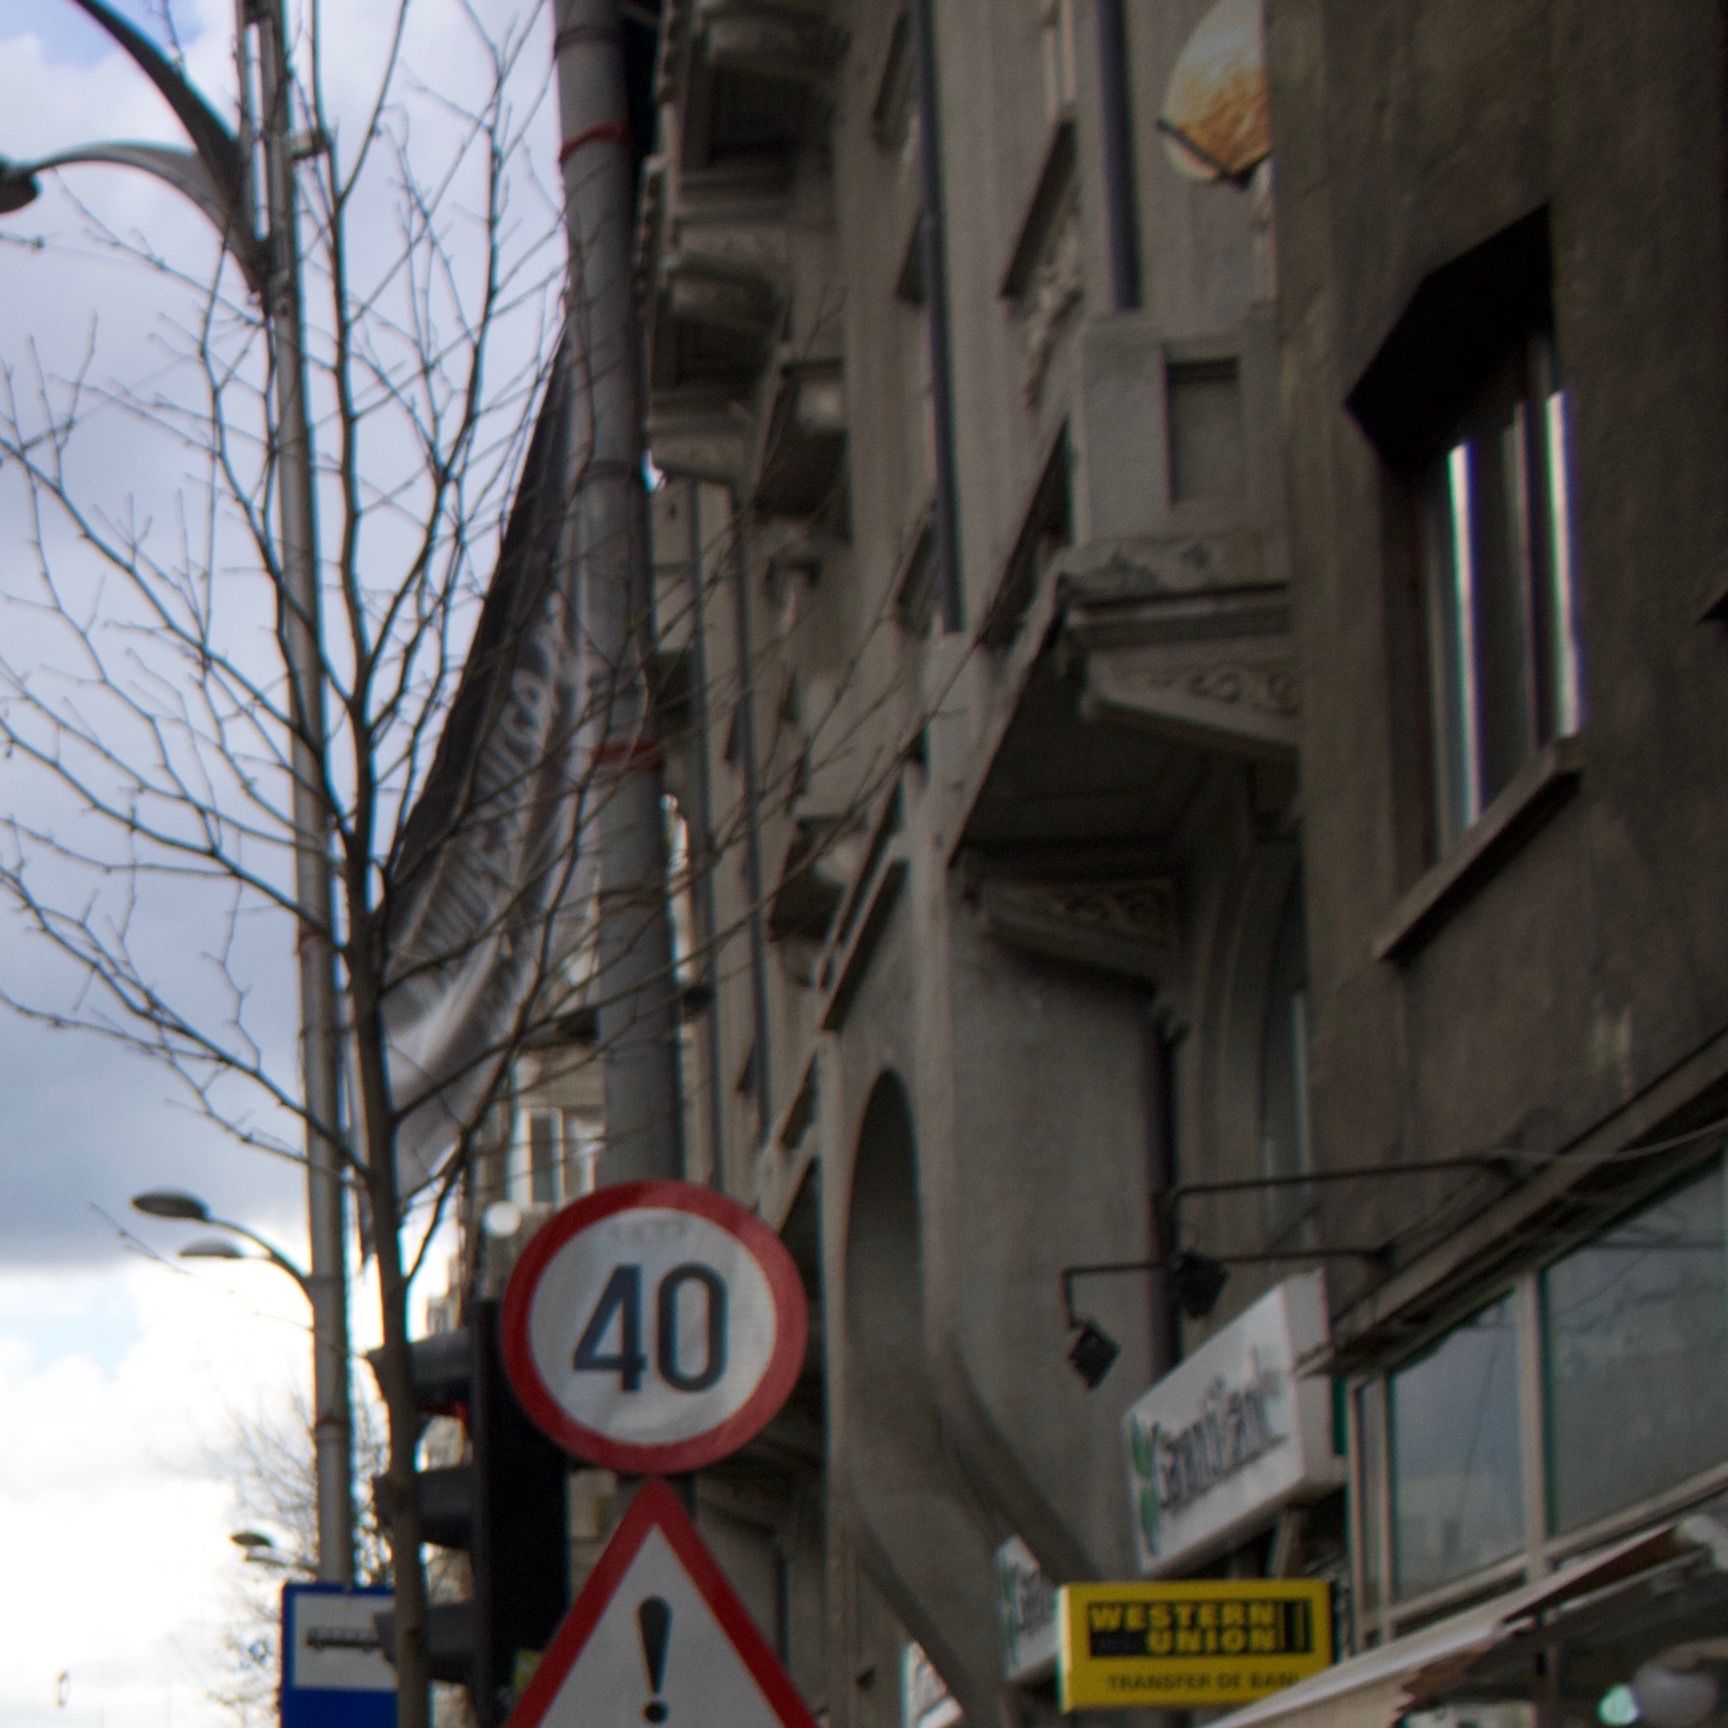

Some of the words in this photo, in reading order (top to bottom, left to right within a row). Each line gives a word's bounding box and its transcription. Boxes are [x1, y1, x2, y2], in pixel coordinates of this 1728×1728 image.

[572, 1262, 728, 1393] 40
[1090, 1603, 1276, 1632] WESTERN
[1146, 1628, 1276, 1653] UNION
[1107, 1672, 1212, 1691] TRANSFER
